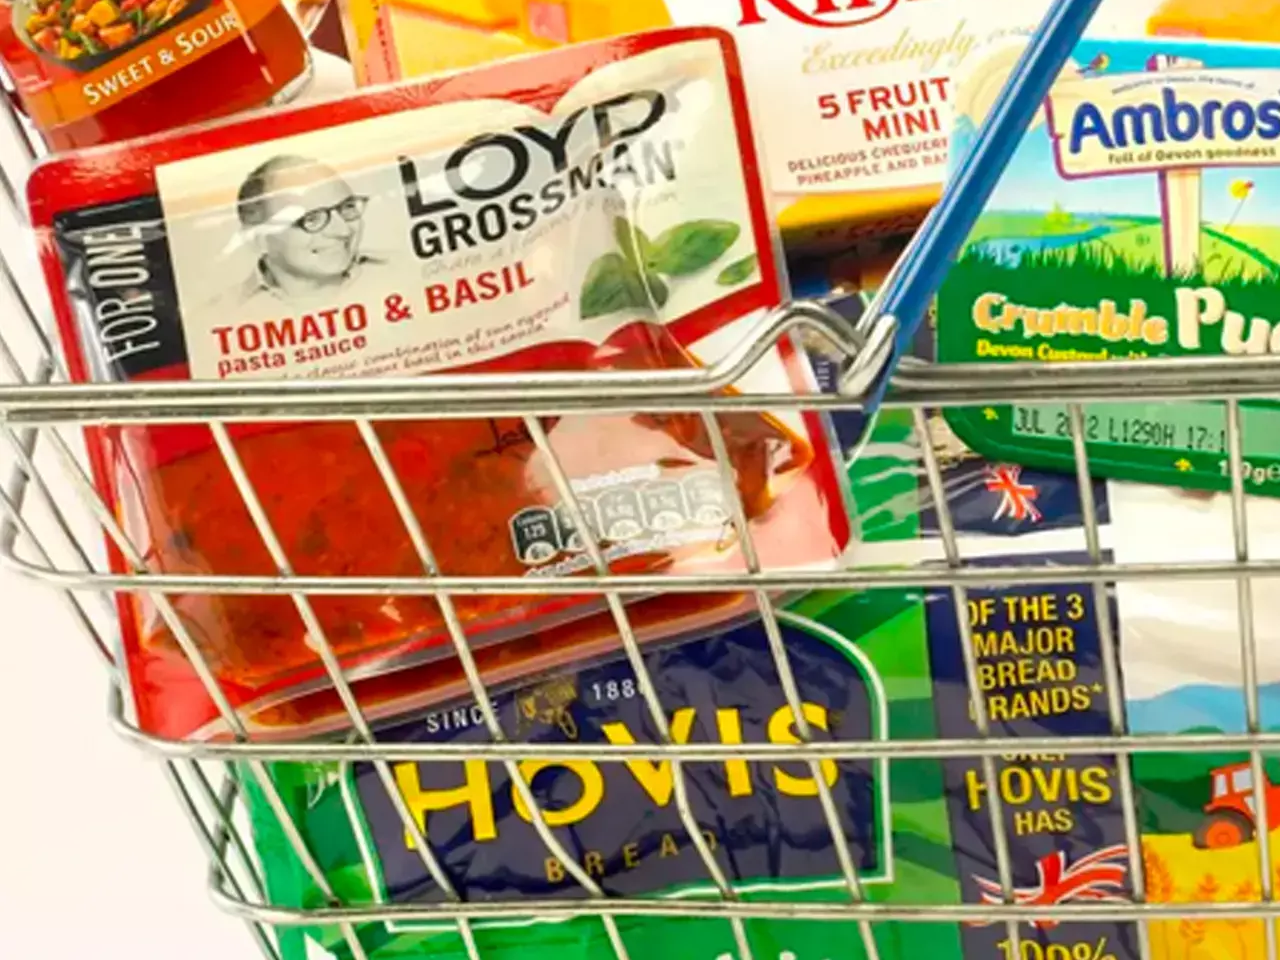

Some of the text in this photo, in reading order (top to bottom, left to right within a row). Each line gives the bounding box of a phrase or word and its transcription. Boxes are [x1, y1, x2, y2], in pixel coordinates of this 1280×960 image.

[802, 18, 977, 74] Exceedingly
[82, 55, 154, 106] SWEET
[157, 44, 176, 67] &
[817, 76, 951, 120] 5 FRUIT
[861, 107, 941, 141] MINI
[396, 90, 667, 218] LOYD
[787, 148, 868, 173] DELICIOUS
[797, 162, 881, 187] PINEAPPLE
[886, 156, 918, 172] AND
[1156, 148, 1203, 162] Devon
[1206, 146, 1277, 161] goodness
[410, 139, 677, 260] GROSSMAN
[212, 260, 535, 356] TOMATO & BASIL
[973, 292, 1169, 345] Crumble
[97, 292, 161, 365] FOR
[217, 335, 368, 380] pasta sauce
[363, 338, 461, 368] combination
[976, 339, 1034, 360] Devon
[1014, 407, 1044, 435] JUL
[1004, 593, 1085, 624] THE 3
[972, 627, 1076, 658] MAJOR
[976, 658, 1077, 691] BREAD
[425, 704, 499, 735] SINCE
[394, 702, 841, 851] HOVIS
[965, 765, 1113, 810] HOVIS
[1014, 808, 1075, 836] HAS
[543, 830, 718, 885] BREAD
